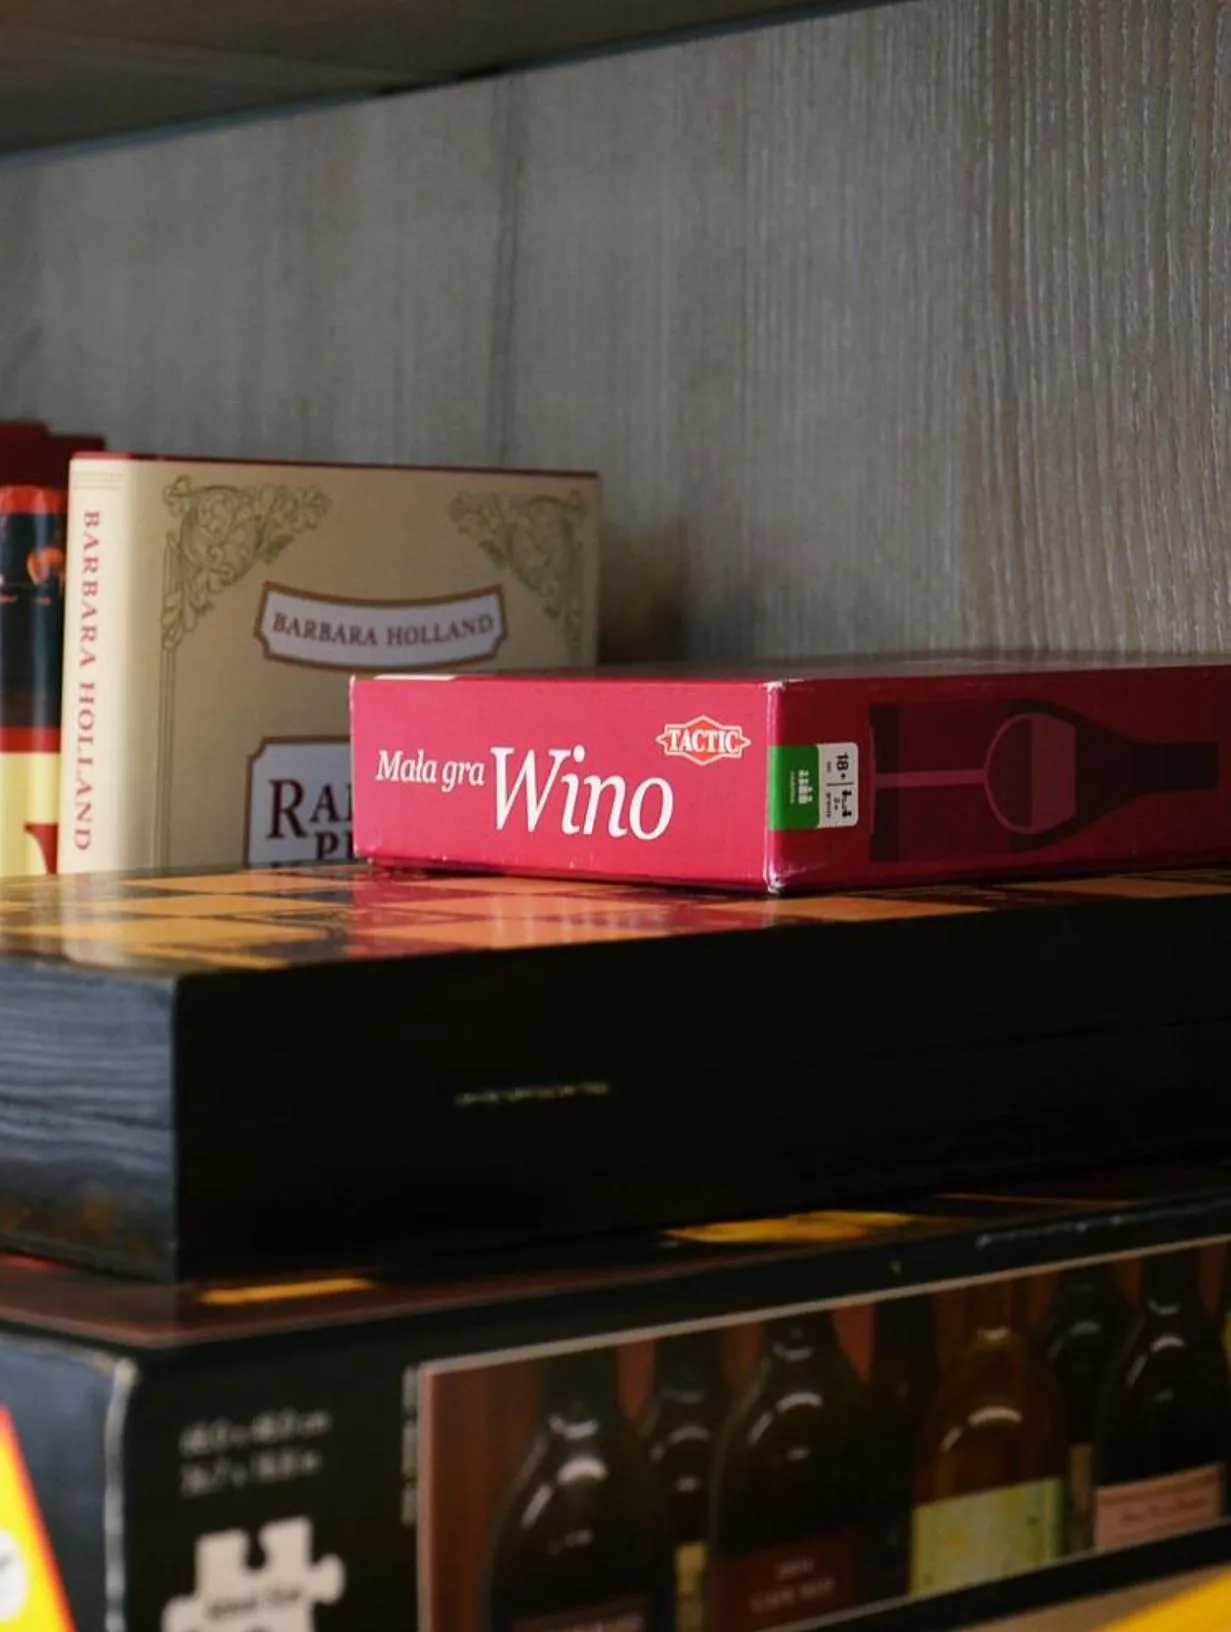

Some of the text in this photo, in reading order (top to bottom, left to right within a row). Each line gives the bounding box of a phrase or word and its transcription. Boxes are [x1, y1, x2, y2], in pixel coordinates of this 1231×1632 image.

[272, 612, 495, 646] BARBARA HOLLAND
[74, 511, 101, 851] BARBARA HOLLAND
[667, 728, 740, 753] TACTIC
[441, 760, 485, 792] gra
[490, 745, 674, 840] Wino
